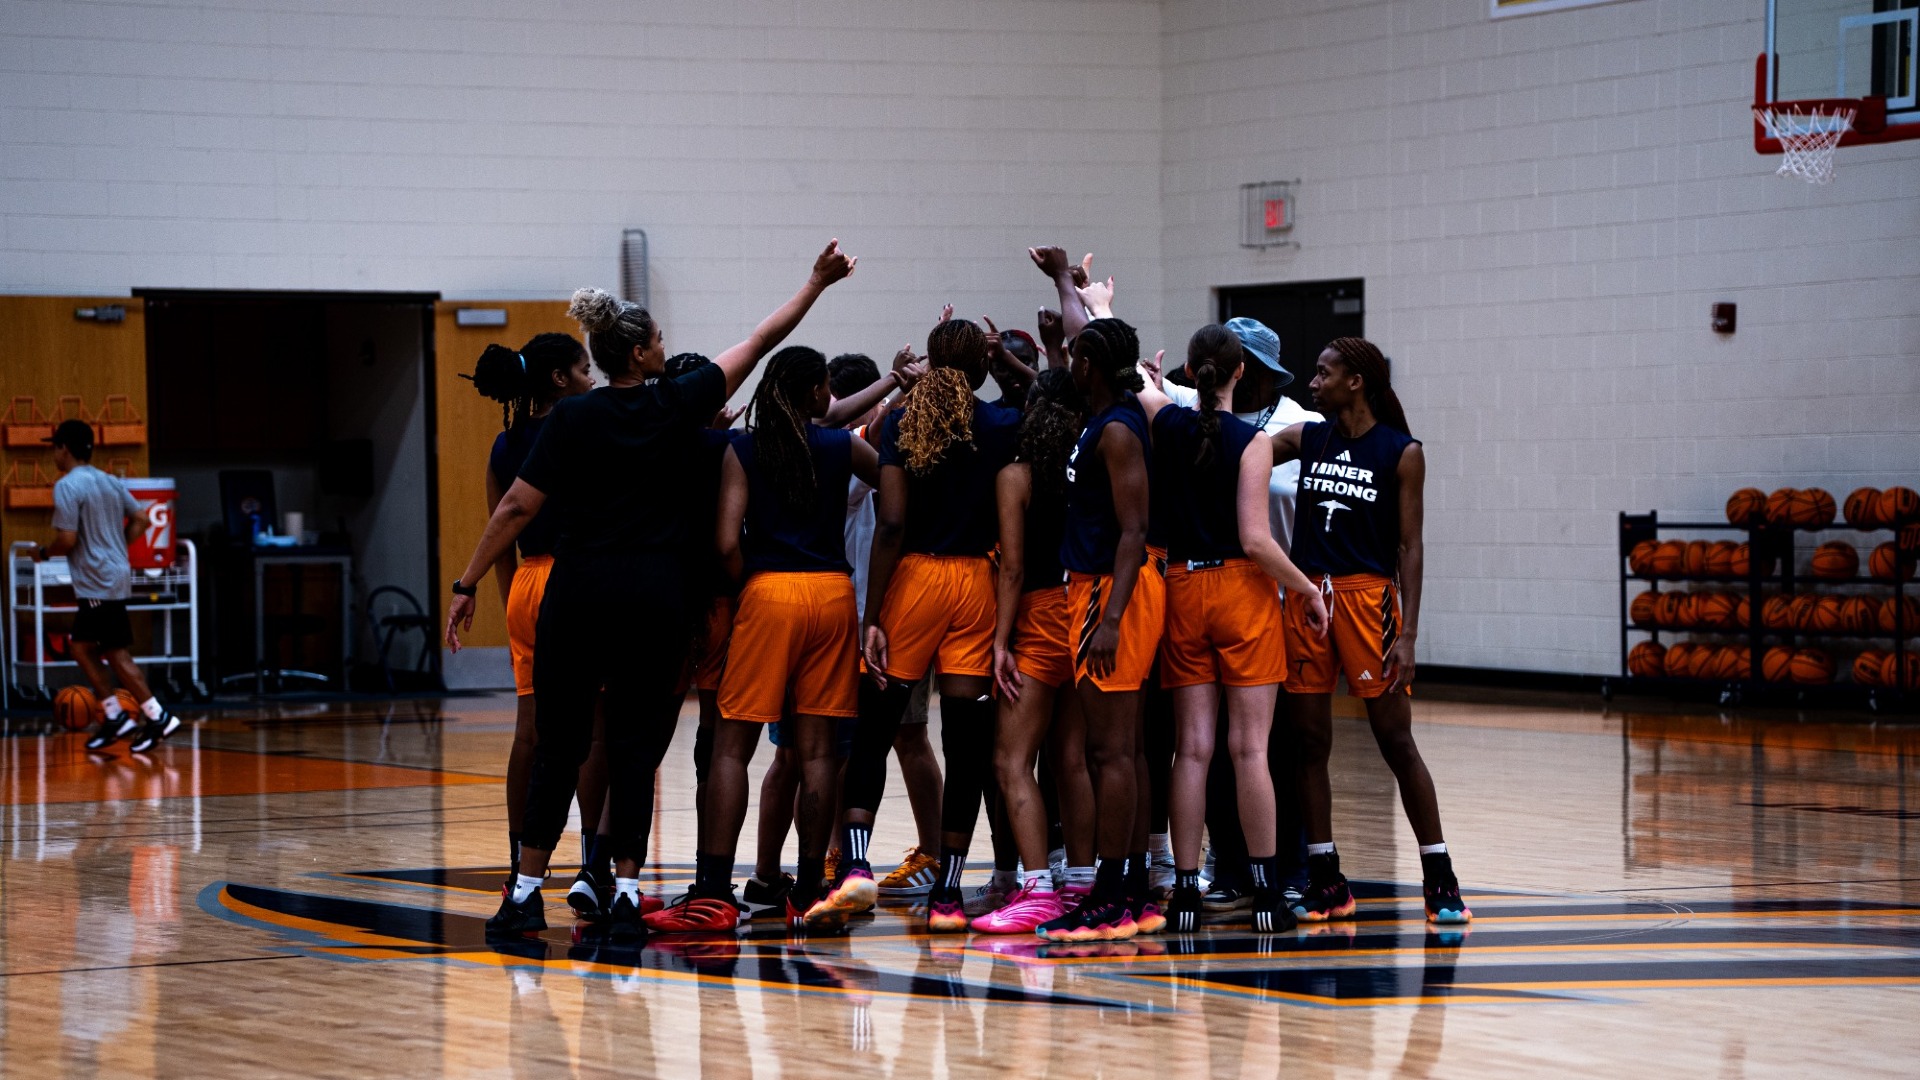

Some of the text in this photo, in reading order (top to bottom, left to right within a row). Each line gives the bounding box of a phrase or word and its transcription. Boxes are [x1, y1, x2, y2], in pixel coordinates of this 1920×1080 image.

[1310, 462, 1374, 484] MINER
[1303, 476, 1378, 502] STRONG
[149, 502, 169, 528] G
